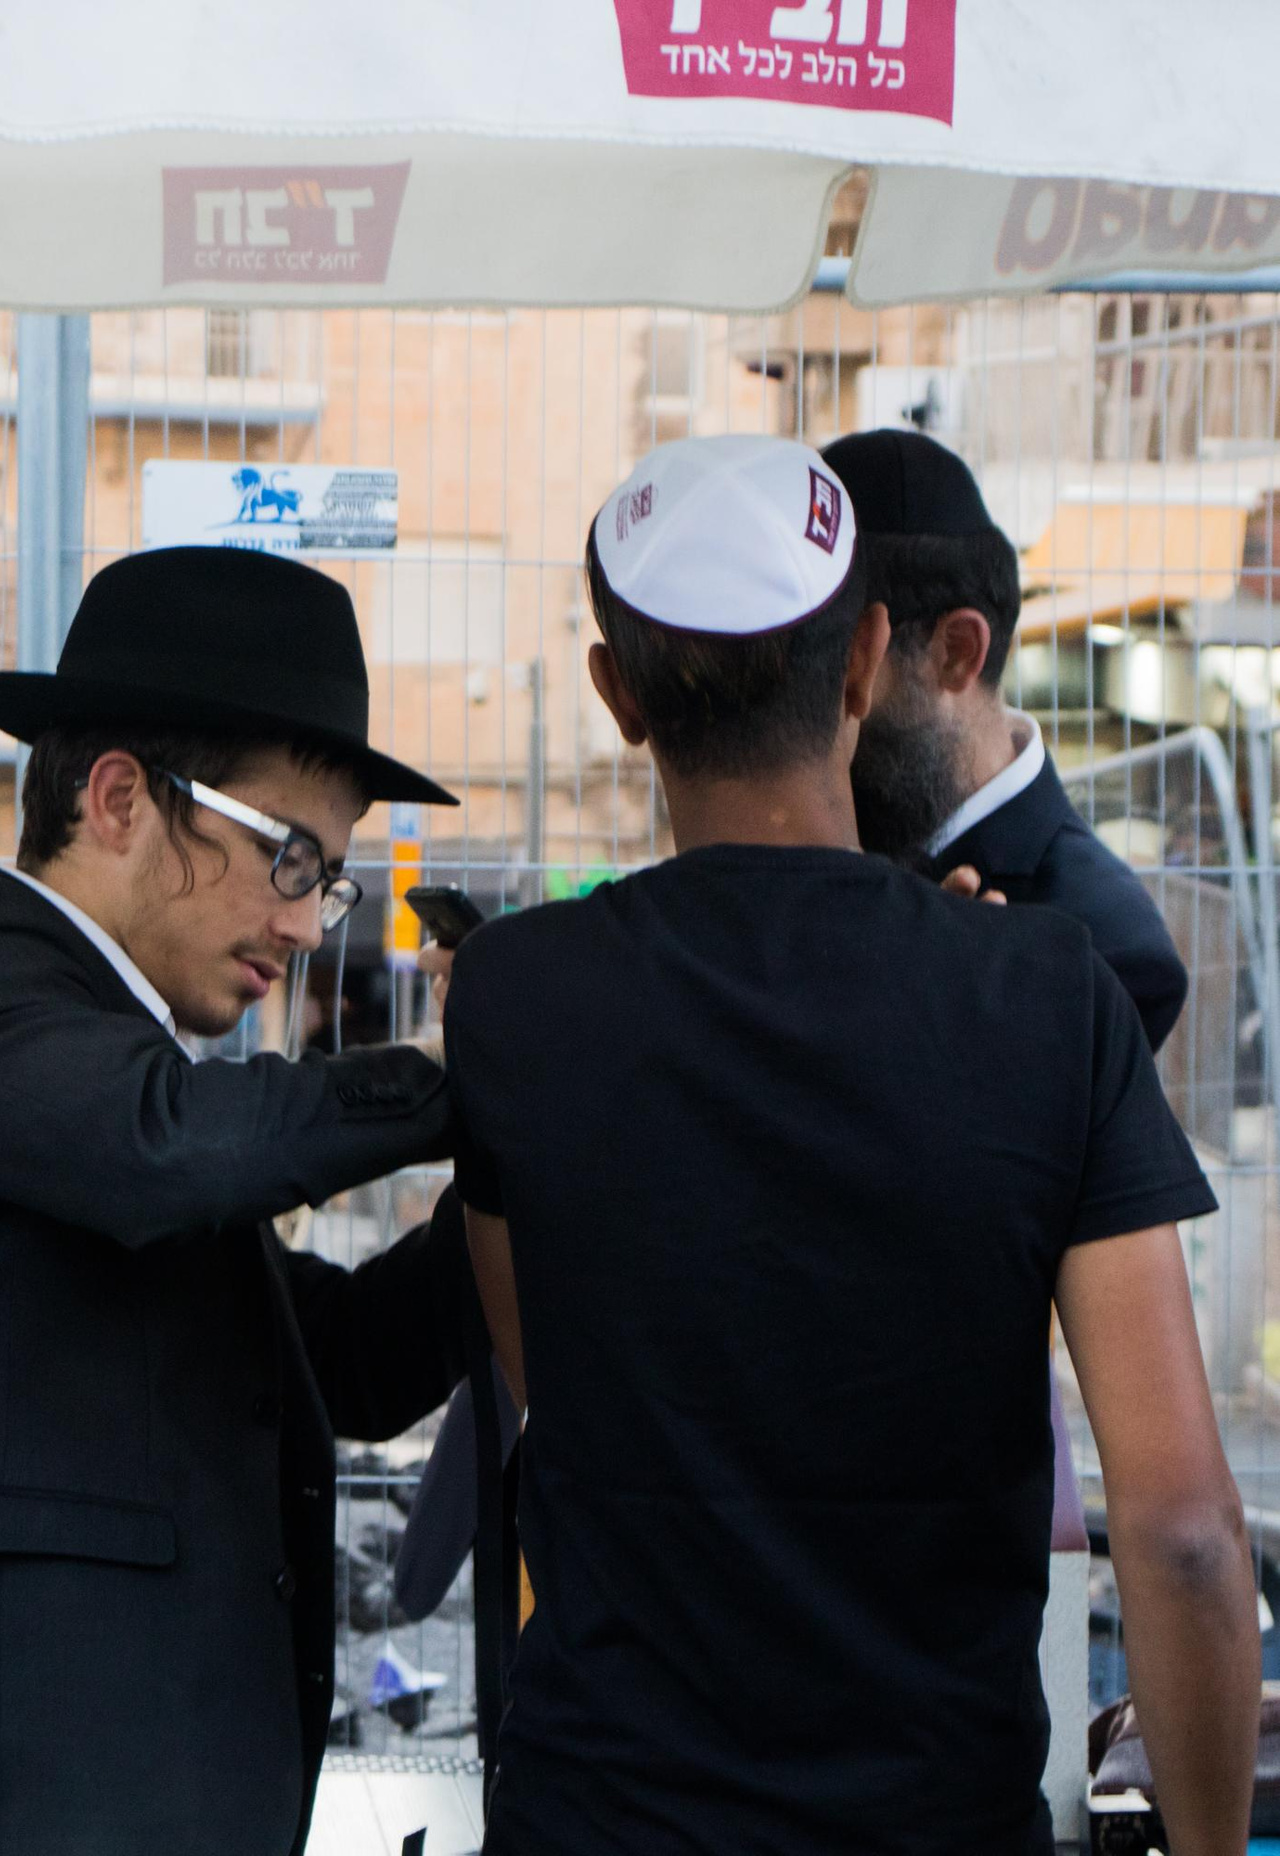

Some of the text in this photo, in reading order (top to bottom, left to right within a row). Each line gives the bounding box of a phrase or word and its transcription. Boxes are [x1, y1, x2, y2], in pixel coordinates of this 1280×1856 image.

[660, 40, 906, 89] כל הלב לכל אחד
